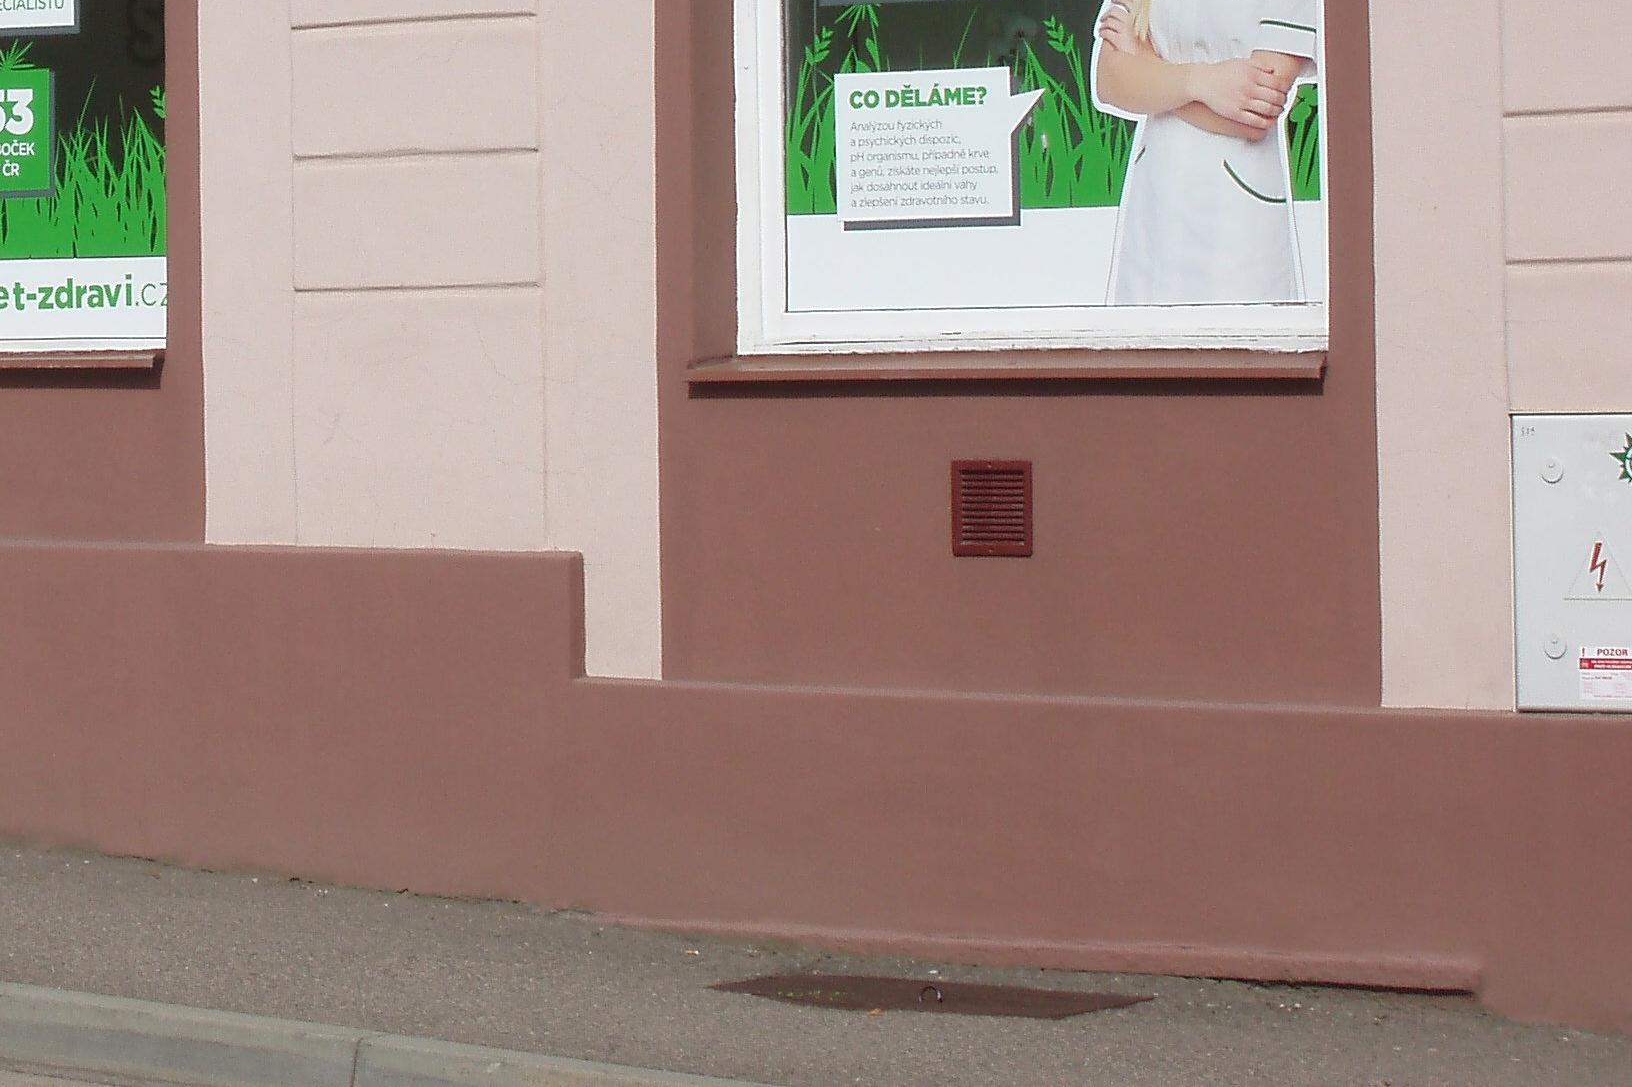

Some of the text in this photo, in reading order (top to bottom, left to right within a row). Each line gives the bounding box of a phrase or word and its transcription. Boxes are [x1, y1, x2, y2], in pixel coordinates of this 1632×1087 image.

[849, 83, 987, 109] CO DĚLÁME?
[850, 121, 894, 133] Analýzou
[851, 152, 864, 162] pH
[3, 157, 19, 176] ČR
[851, 184, 863, 194] jak
